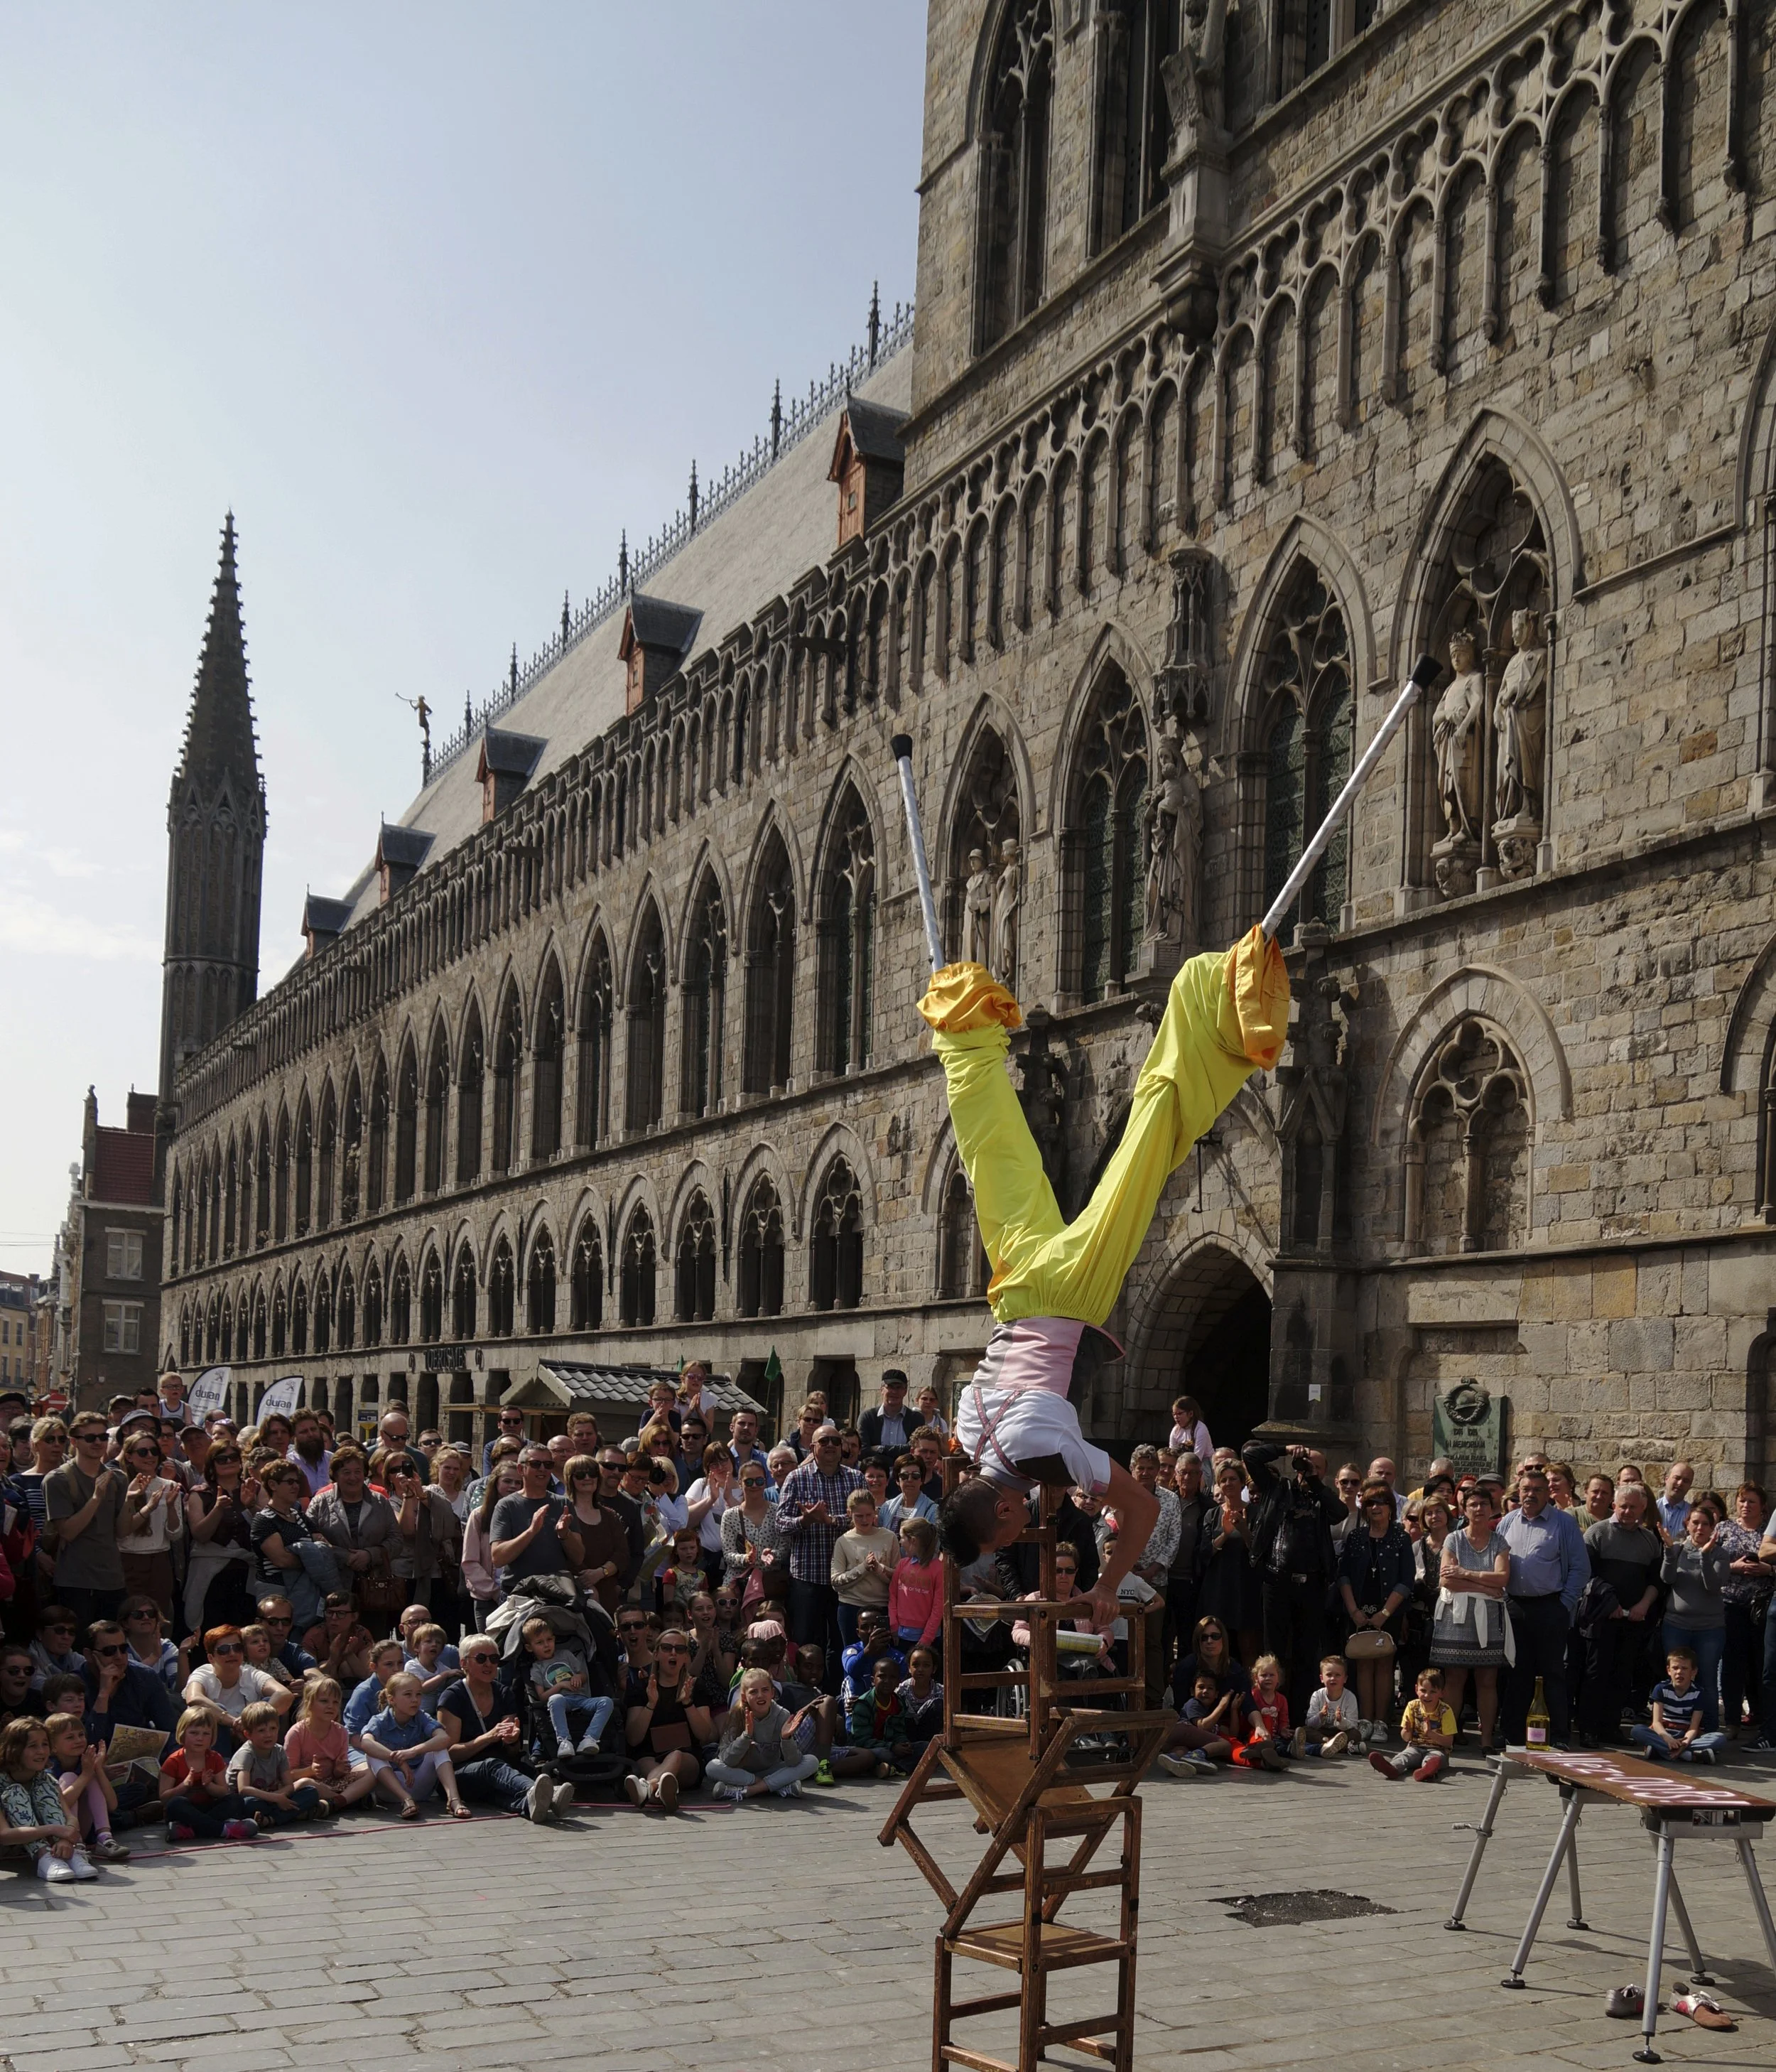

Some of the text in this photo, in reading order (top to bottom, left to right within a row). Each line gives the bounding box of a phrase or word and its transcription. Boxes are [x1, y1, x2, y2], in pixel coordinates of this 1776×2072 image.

[423, 1347, 467, 1371] TOERISME
[195, 1385, 220, 1401] duran
[266, 1395, 292, 1409] duran
[1453, 1440, 1485, 1448] MEMORIAM
